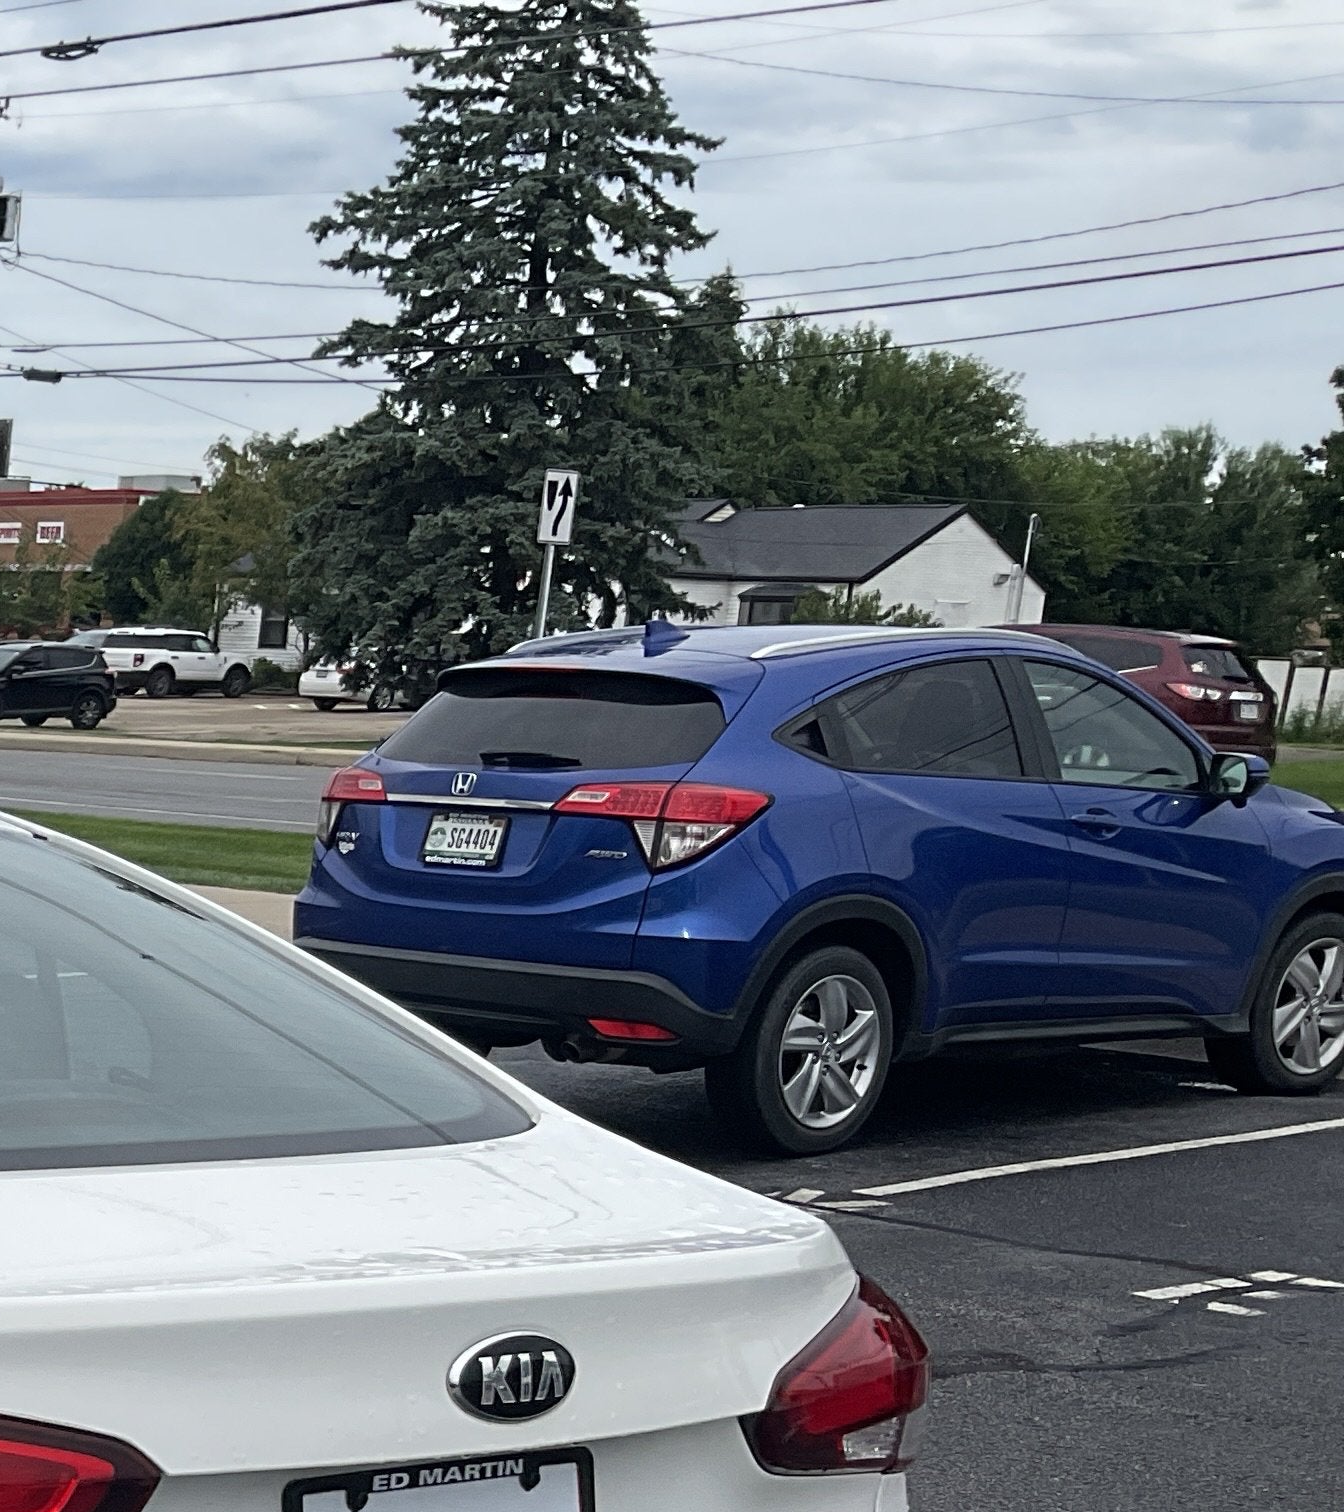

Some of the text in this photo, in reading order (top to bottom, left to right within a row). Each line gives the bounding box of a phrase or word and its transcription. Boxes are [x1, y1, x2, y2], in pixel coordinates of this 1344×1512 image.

[447, 827, 498, 851] SG4404
[478, 1350, 564, 1405] KIA
[372, 1459, 524, 1491] ED MARTIN
